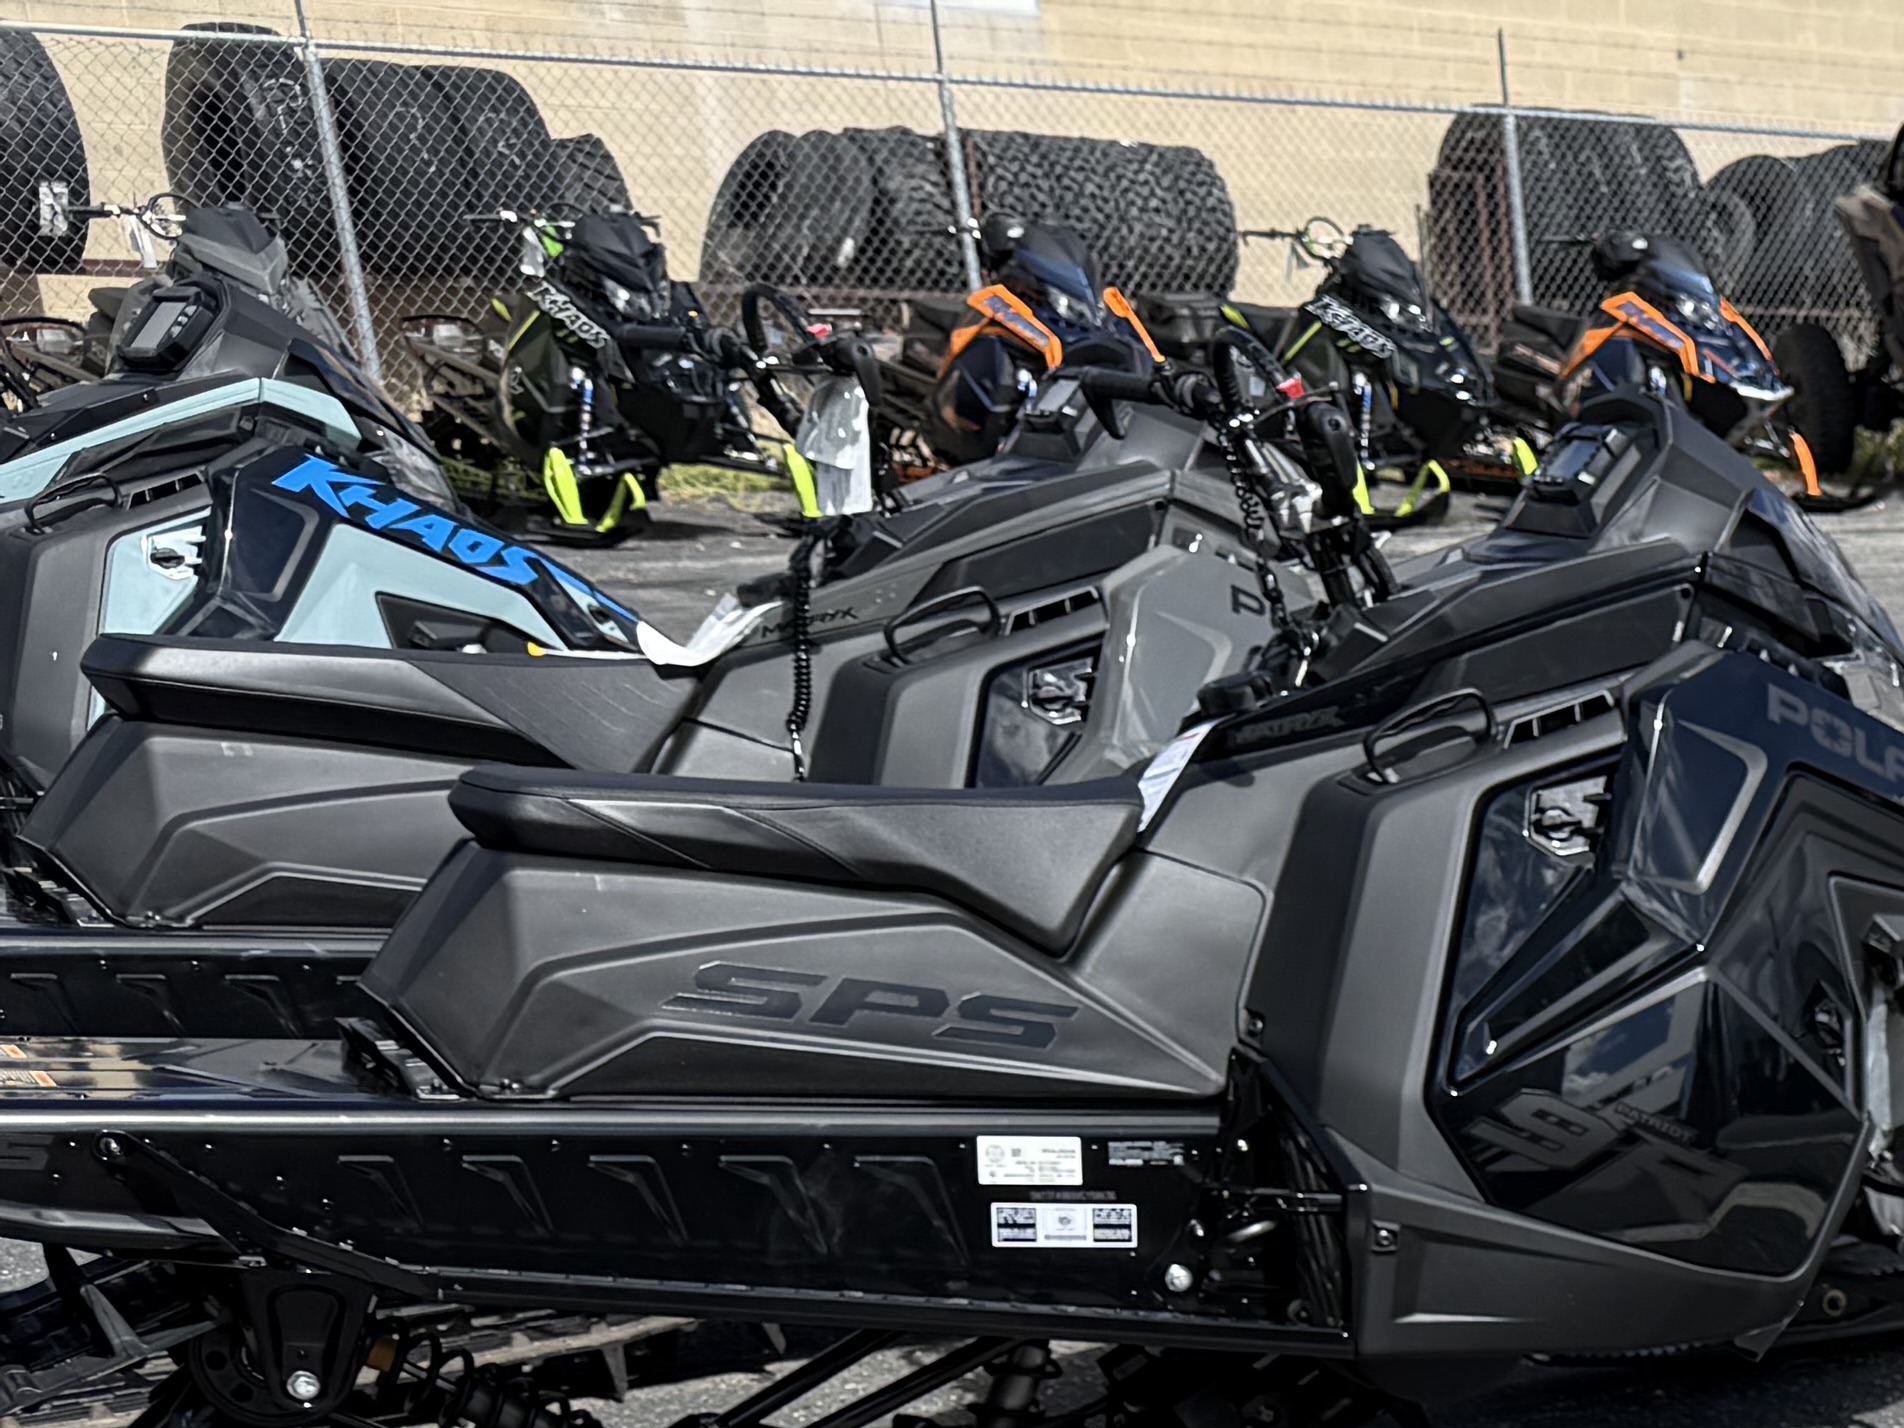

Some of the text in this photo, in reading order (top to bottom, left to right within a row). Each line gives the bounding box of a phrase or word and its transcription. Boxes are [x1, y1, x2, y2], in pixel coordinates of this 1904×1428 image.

[525, 280, 611, 348] KHAOS
[272, 452, 540, 586] KHAOS
[659, 960, 1079, 1050] SPS
[1614, 1101, 1699, 1145] PATRIOT
